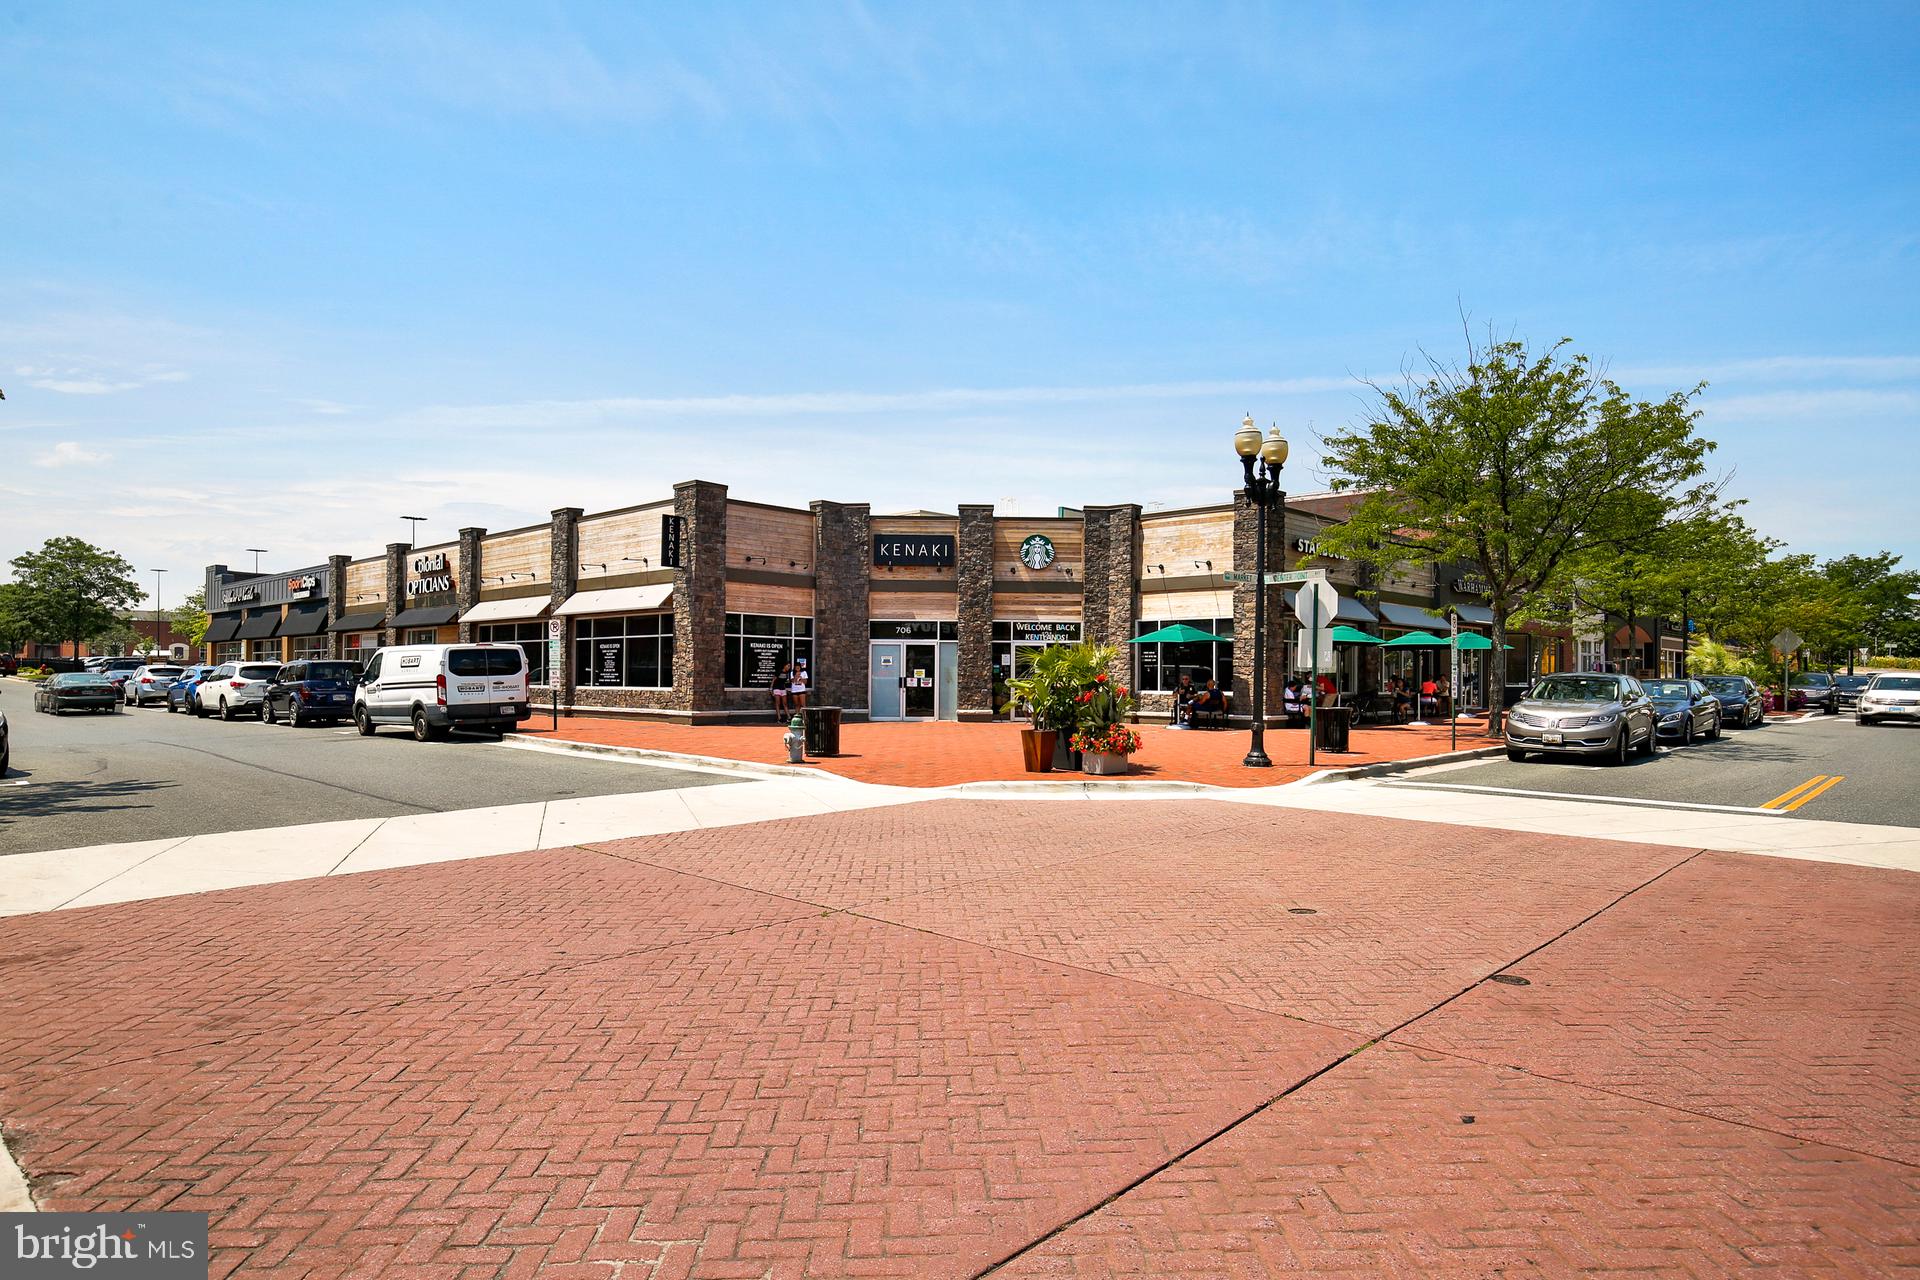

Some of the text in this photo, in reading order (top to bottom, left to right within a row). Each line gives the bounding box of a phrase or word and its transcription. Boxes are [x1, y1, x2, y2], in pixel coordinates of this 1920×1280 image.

[880, 543, 948, 557] KENAKI
[413, 552, 444, 573] Colonial
[1233, 573, 1253, 582] MARKET
[407, 575, 450, 596] OPTICIANS
[895, 626, 912, 634] 706
[1016, 622, 1076, 632] WELCOME BACK
